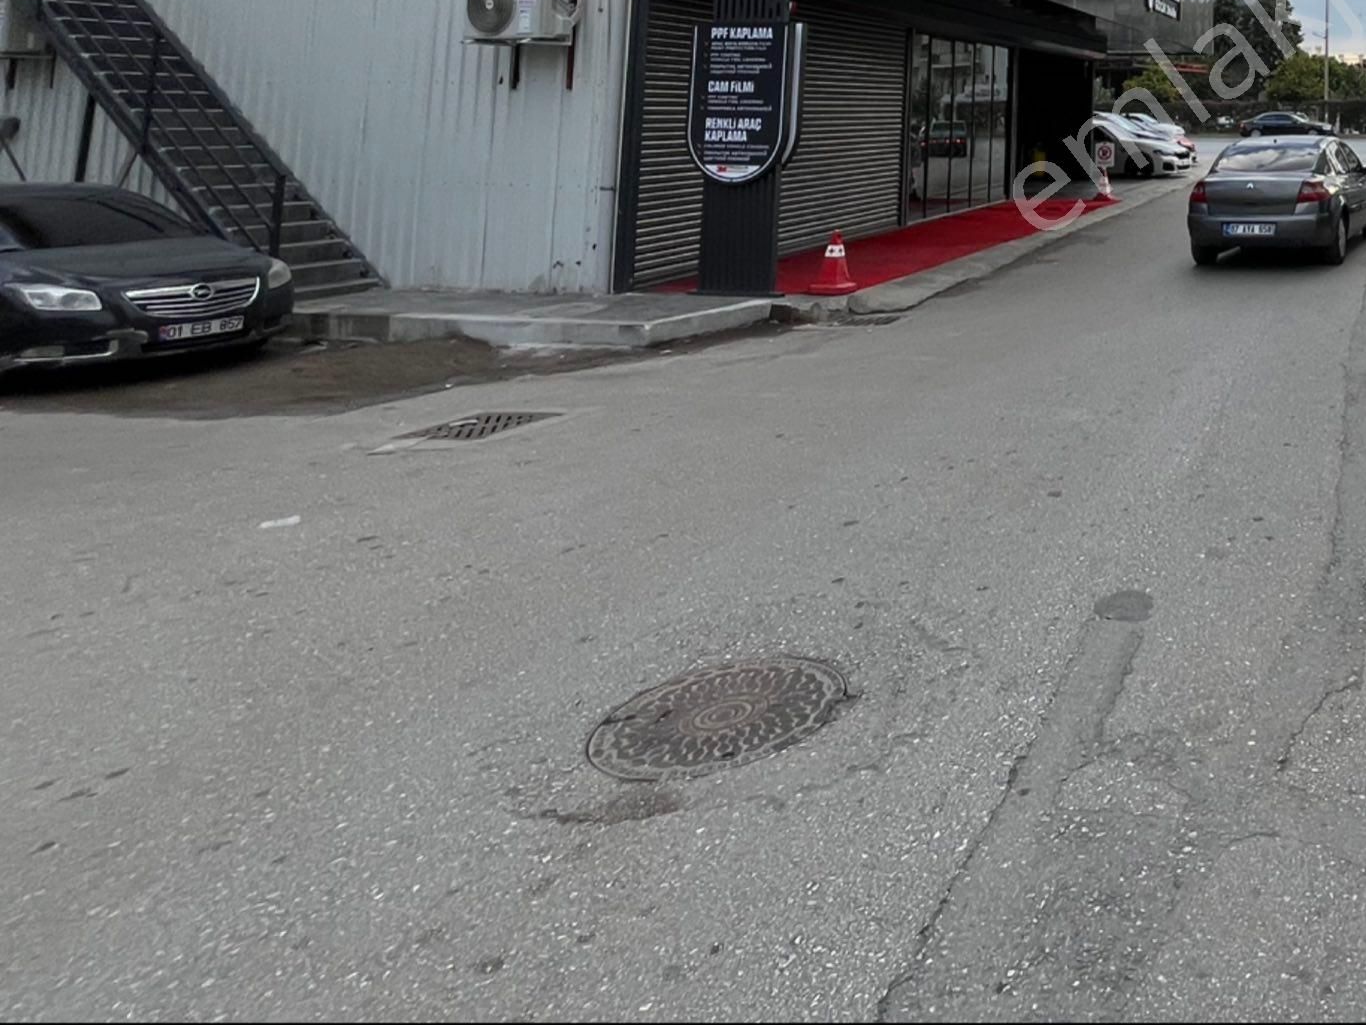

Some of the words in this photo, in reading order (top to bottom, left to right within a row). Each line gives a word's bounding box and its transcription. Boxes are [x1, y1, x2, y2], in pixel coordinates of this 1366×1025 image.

[711, 27, 729, 39] PPF
[729, 27, 774, 39] KAPLAMA
[708, 80, 729, 93] CAM
[737, 117, 762, 131] ARAÇ
[704, 130, 748, 142] KAPLAMA
[168, 326, 183, 338] 01
[191, 322, 211, 335] EB
